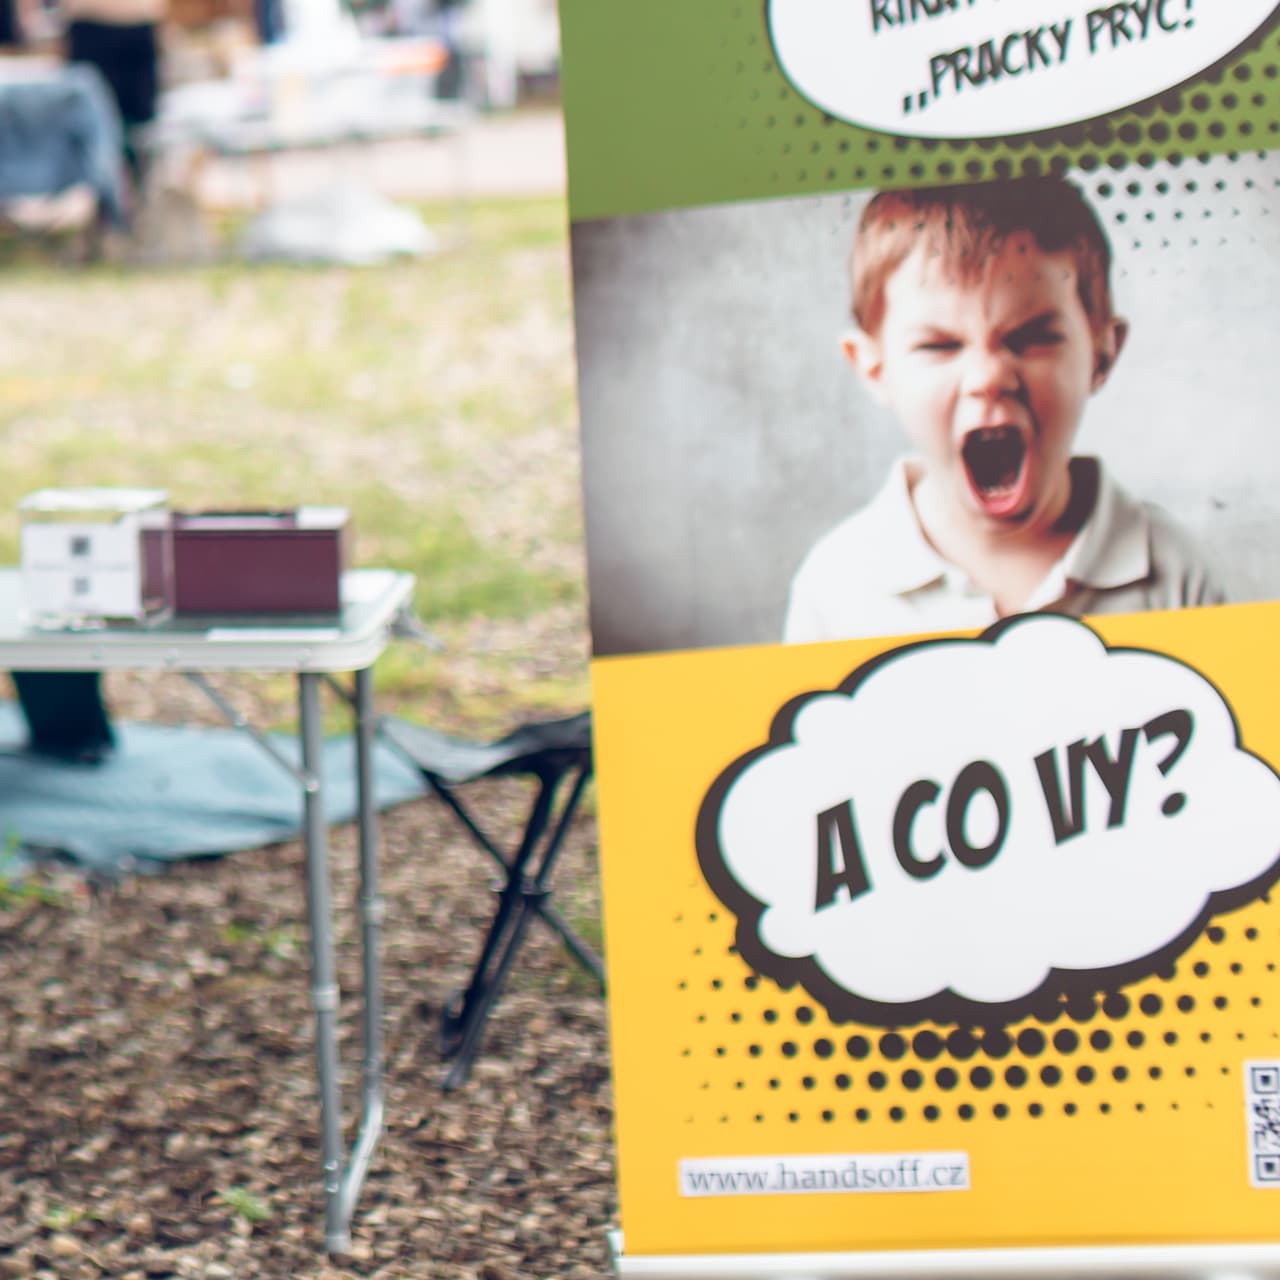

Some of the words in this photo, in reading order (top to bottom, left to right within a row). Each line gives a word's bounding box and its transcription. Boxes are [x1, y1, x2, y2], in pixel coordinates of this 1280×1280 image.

[813, 798, 873, 914] A
[891, 759, 1013, 881] CO
[1034, 707, 1196, 846] VY?
[687, 1158, 966, 1192] www.handsoff.cz
